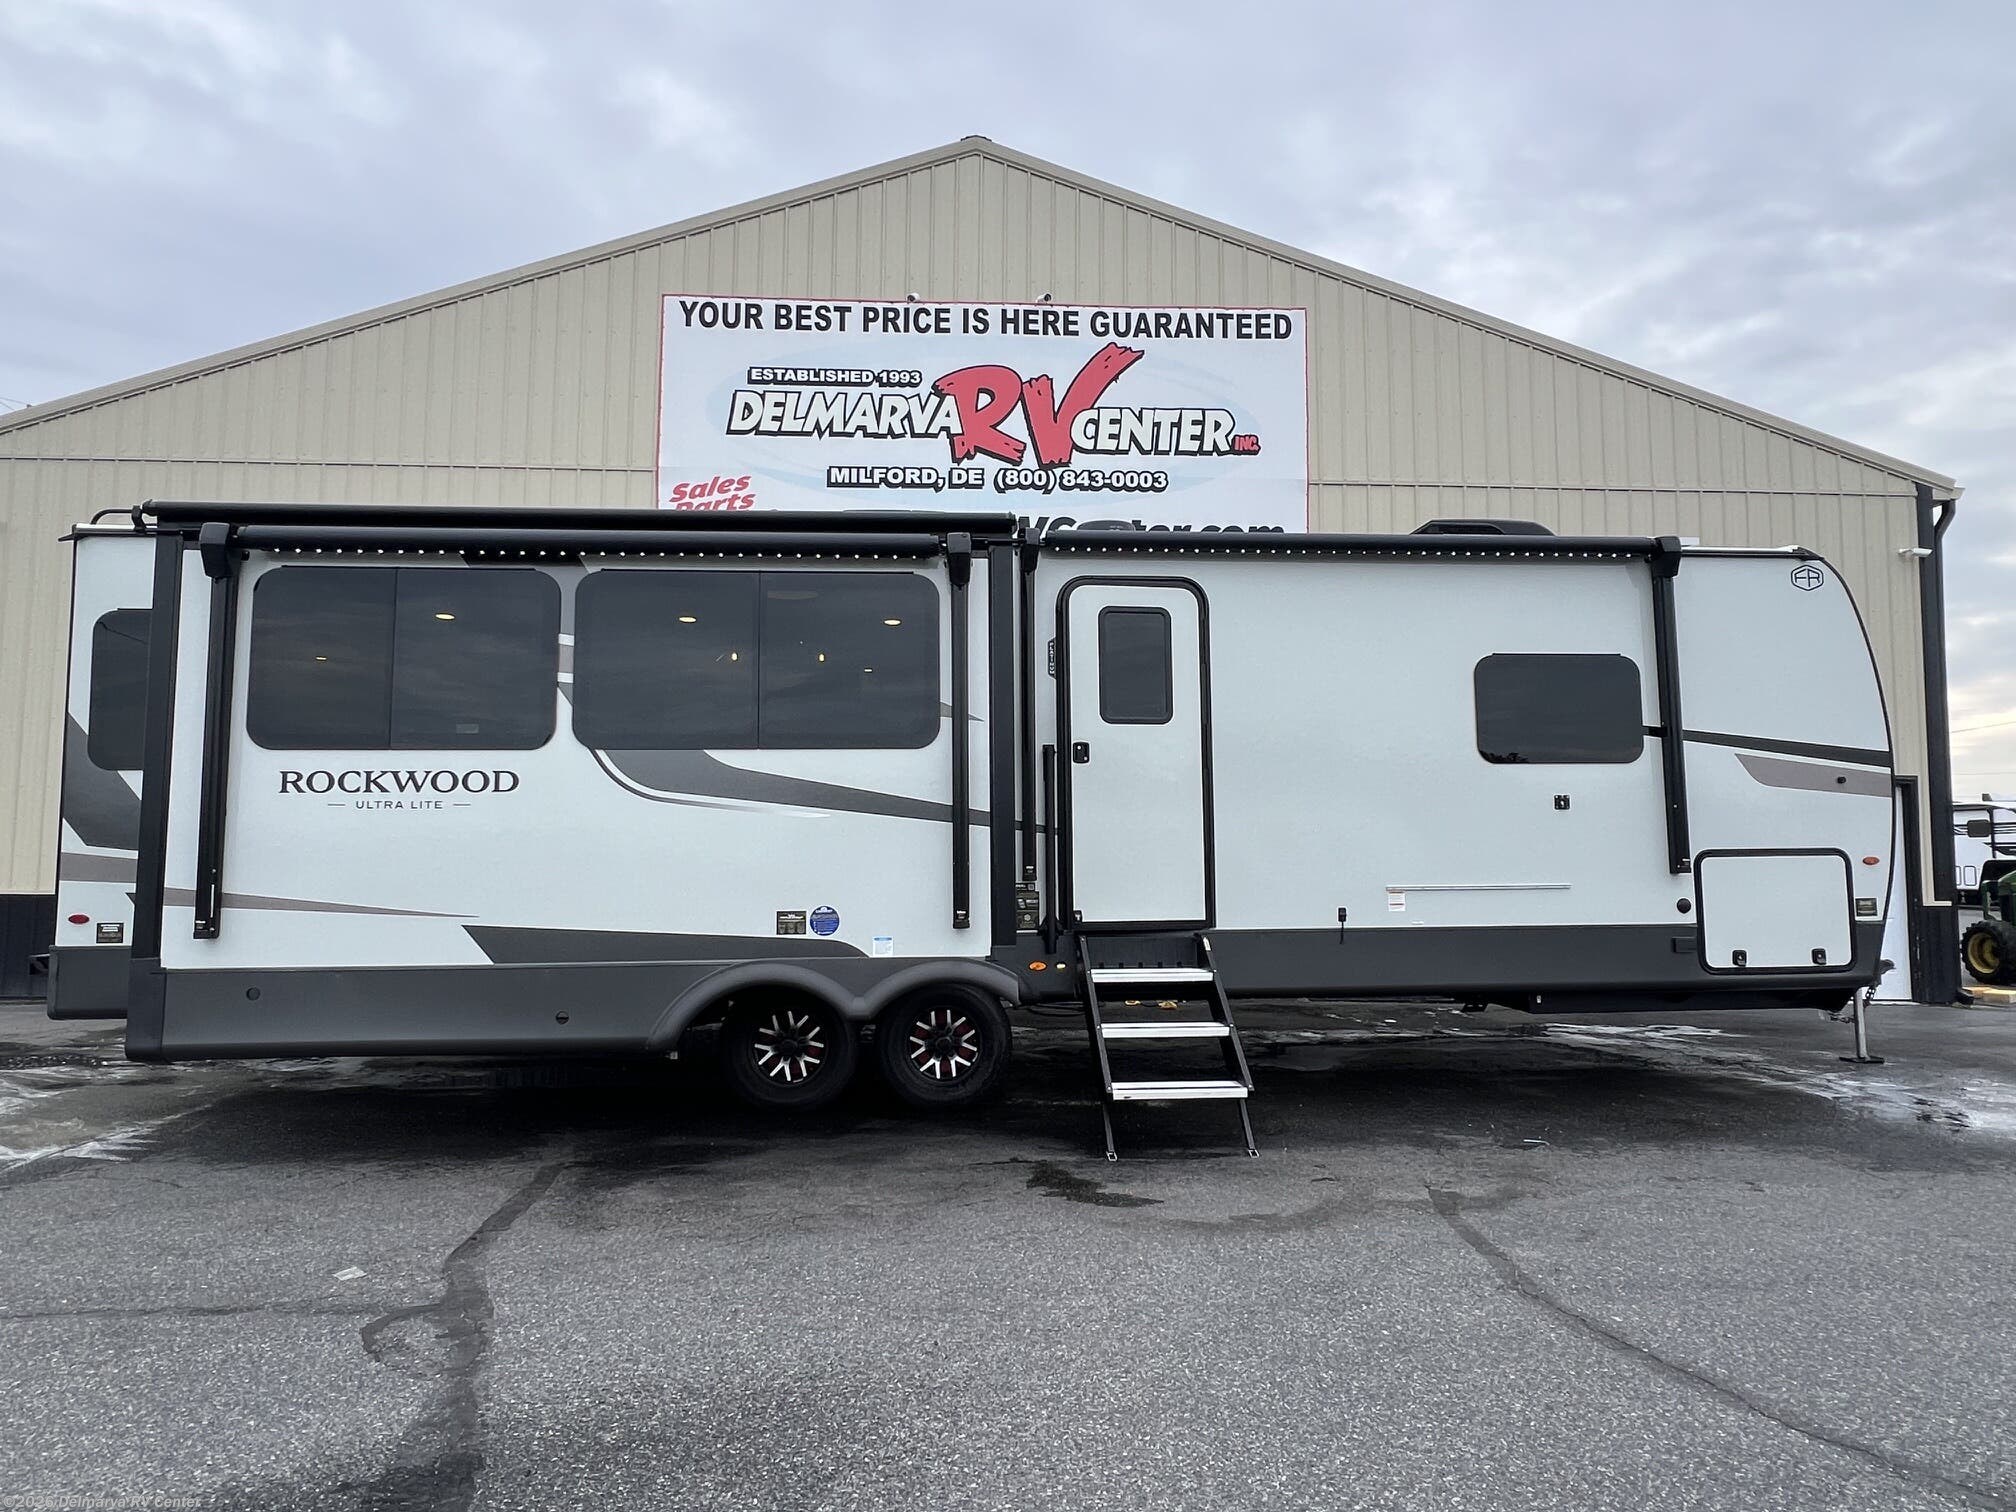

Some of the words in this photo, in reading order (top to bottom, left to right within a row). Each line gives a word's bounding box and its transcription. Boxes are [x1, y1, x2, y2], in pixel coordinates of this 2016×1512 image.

[679, 301, 764, 330] YOUR
[773, 304, 852, 332] BEST
[862, 306, 951, 334] PRICE
[962, 308, 990, 334] IS
[1000, 309, 1080, 336] HERE
[1090, 311, 1293, 340] GUARANTEED
[748, 366, 874, 386] ESTABLISHED
[877, 369, 922, 387] 1993
[726, 389, 963, 440] DELMARVA
[932, 341, 1145, 467] RV
[1069, 407, 1235, 456] CENTER
[668, 475, 752, 503] Sales
[827, 465, 946, 492] MILFORD,
[951, 467, 985, 489] DE
[994, 468, 1056, 495] (800)
[1059, 470, 1169, 492] 843-0003
[278, 770, 520, 794] ROCKWOOD
[355, 800, 404, 810] ULTRA
[410, 800, 444, 810] LITE
